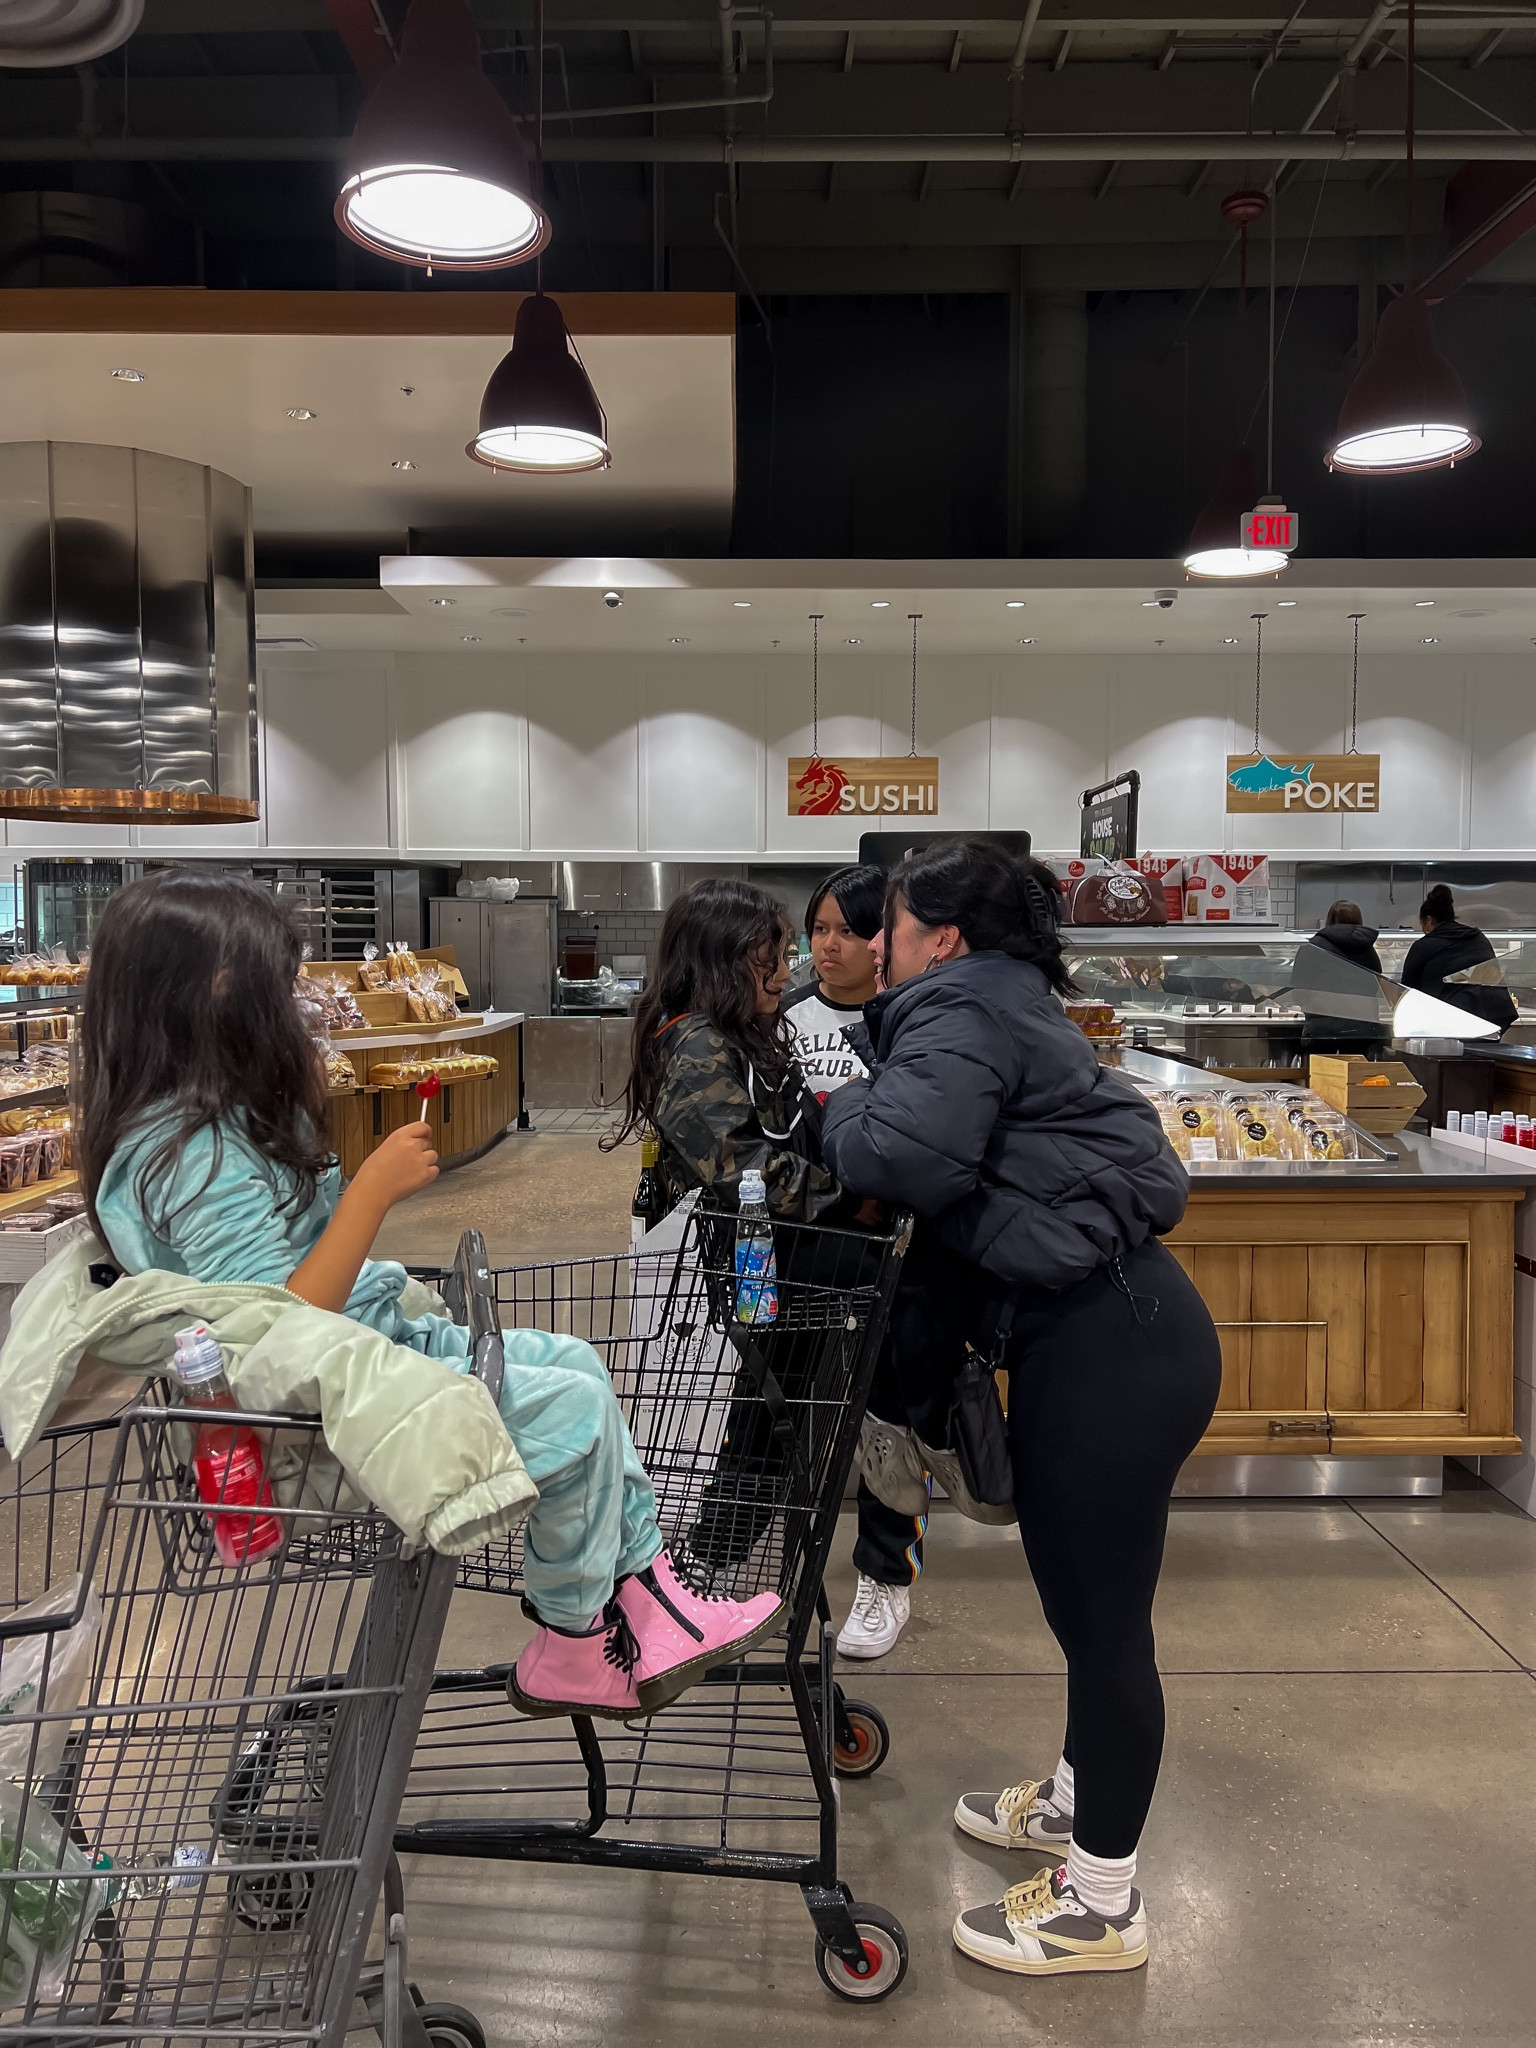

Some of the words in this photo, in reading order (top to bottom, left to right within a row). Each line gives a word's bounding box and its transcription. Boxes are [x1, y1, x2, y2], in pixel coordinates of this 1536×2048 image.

[1252, 515, 1293, 546] EXIT
[839, 784, 934, 812] SUSHI
[1284, 782, 1375, 809] POKE
[1092, 817, 1113, 839] HOUSE
[1137, 858, 1168, 873] 1946
[1220, 855, 1255, 870] 1946
[804, 1058, 854, 1078] CLUB
